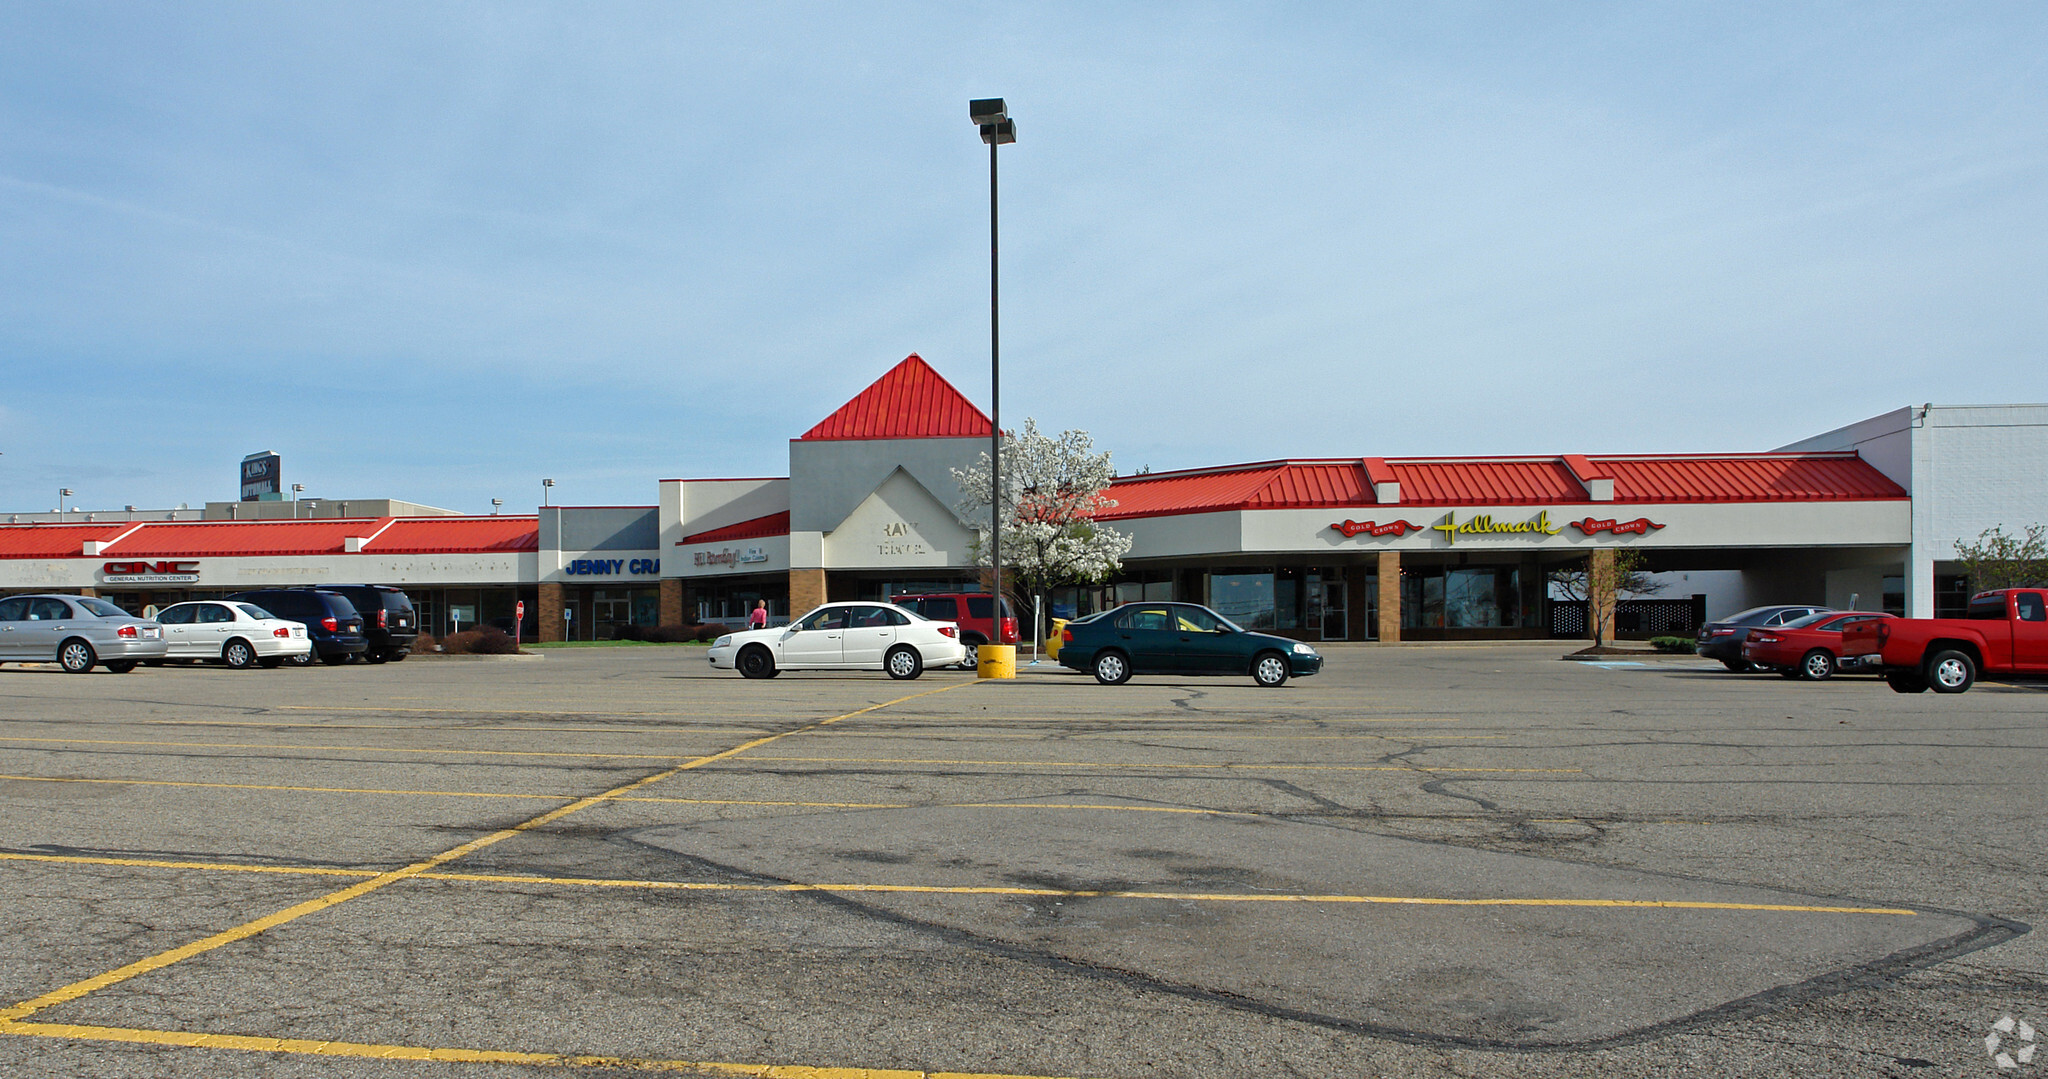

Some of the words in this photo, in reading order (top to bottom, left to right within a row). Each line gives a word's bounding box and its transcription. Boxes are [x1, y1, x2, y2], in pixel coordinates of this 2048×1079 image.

[1350, 523, 1371, 531] GOLD
[1374, 525, 1399, 534] CROWN
[1431, 509, 1564, 545] Hallmark
[1591, 521, 1612, 529] GOLD
[1615, 523, 1641, 532] CROWN
[103, 560, 200, 574] GNC
[565, 559, 625, 575] JENNY
